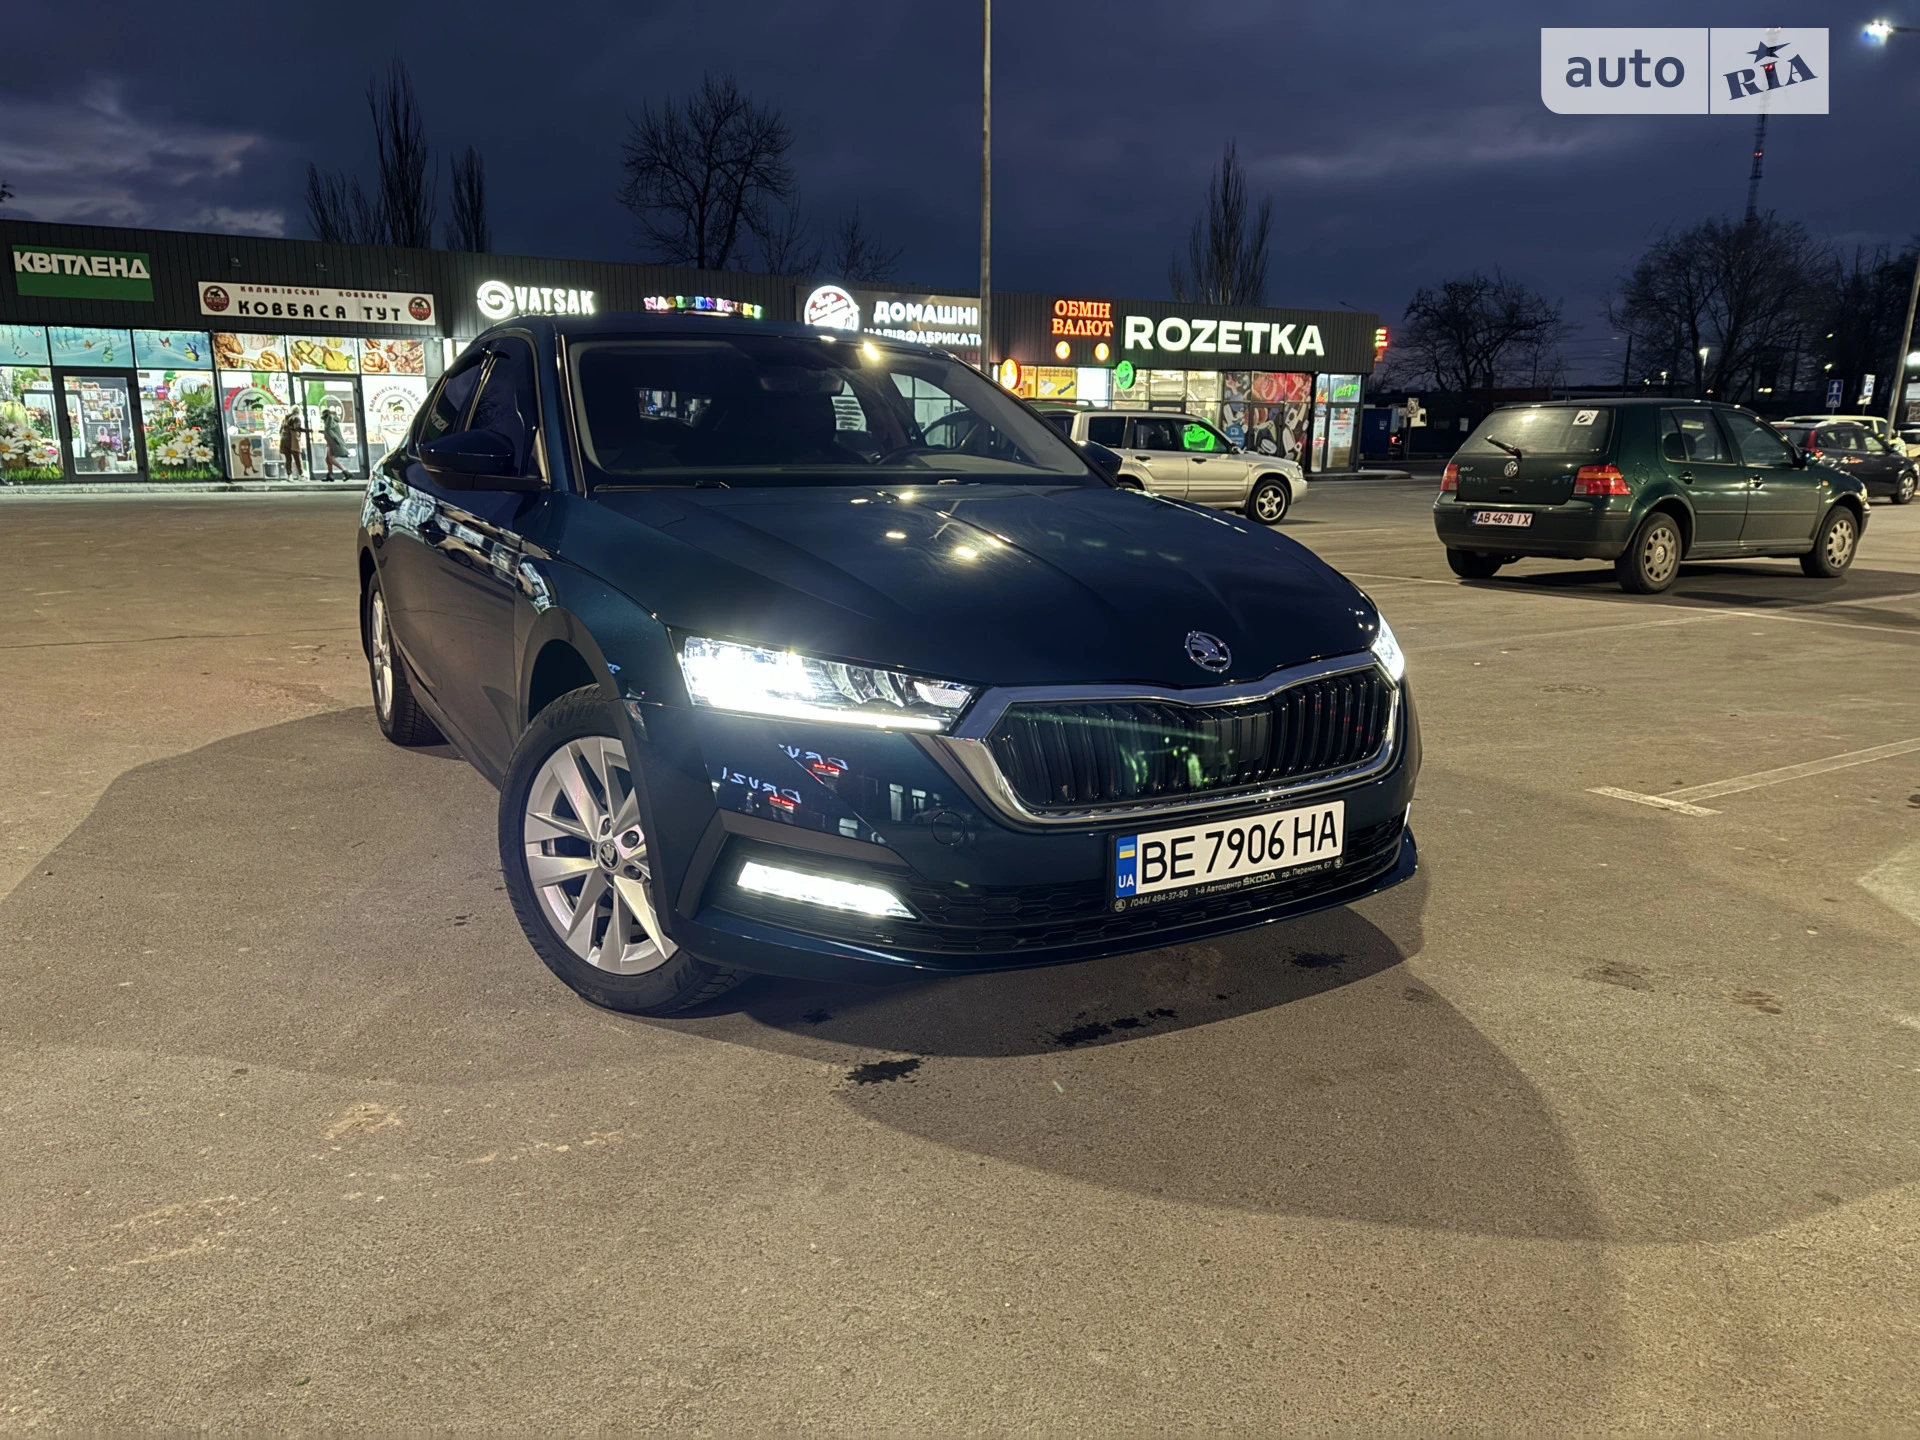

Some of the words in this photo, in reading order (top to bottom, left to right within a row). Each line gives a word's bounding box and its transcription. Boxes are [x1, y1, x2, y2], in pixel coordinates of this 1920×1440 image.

[13, 251, 150, 279] КВІТЛЕНД
[238, 300, 347, 319] КОВБАСА
[363, 306, 401, 321] ТУТ
[513, 286, 595, 314] VATSAK
[1054, 300, 1111, 318] ОБМІН
[873, 301, 978, 325] ДОМАШНІ
[1051, 318, 1113, 337] ВАЛЮТ
[1124, 315, 1325, 356] ROZETKA
[1477, 512, 1491, 523] AB
[1491, 513, 1514, 524] 4678
[1141, 835, 1196, 885] BE
[1205, 819, 1285, 874] 7906
[1293, 810, 1338, 857] HA
[1118, 875, 1135, 889] UA
[1130, 895, 1151, 908] /044/
[1152, 889, 1189, 903] 494-37-90
[1205, 879, 1242, 895] Автоцентр
[1242, 872, 1276, 887] ŠKODA
